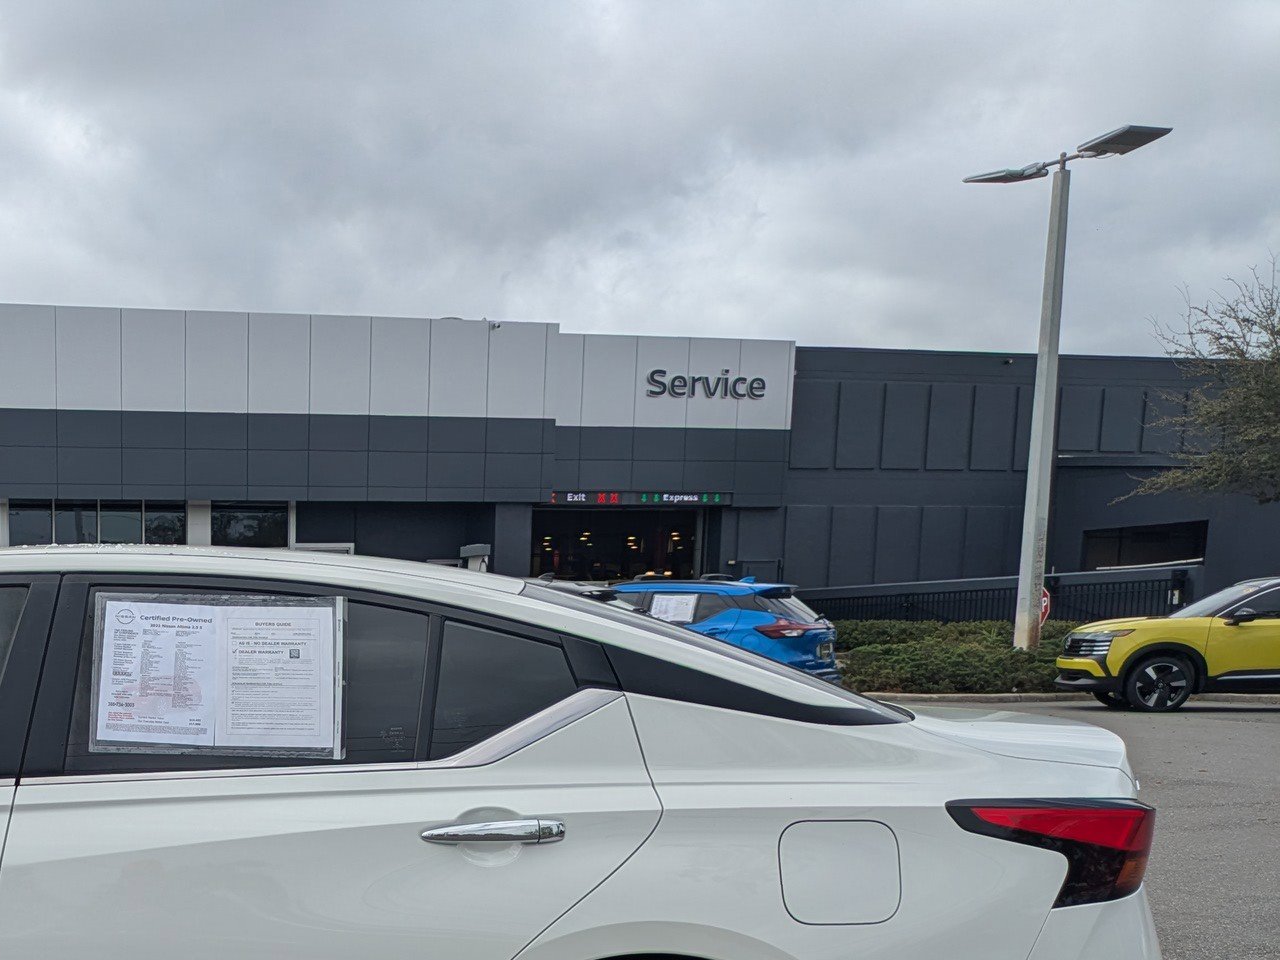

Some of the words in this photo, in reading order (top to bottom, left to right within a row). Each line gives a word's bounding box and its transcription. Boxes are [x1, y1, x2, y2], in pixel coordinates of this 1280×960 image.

[647, 368, 766, 400] Service
[567, 493, 586, 502] Exit
[662, 493, 699, 503] Express
[172, 616, 213, 624] Pre-Owned
